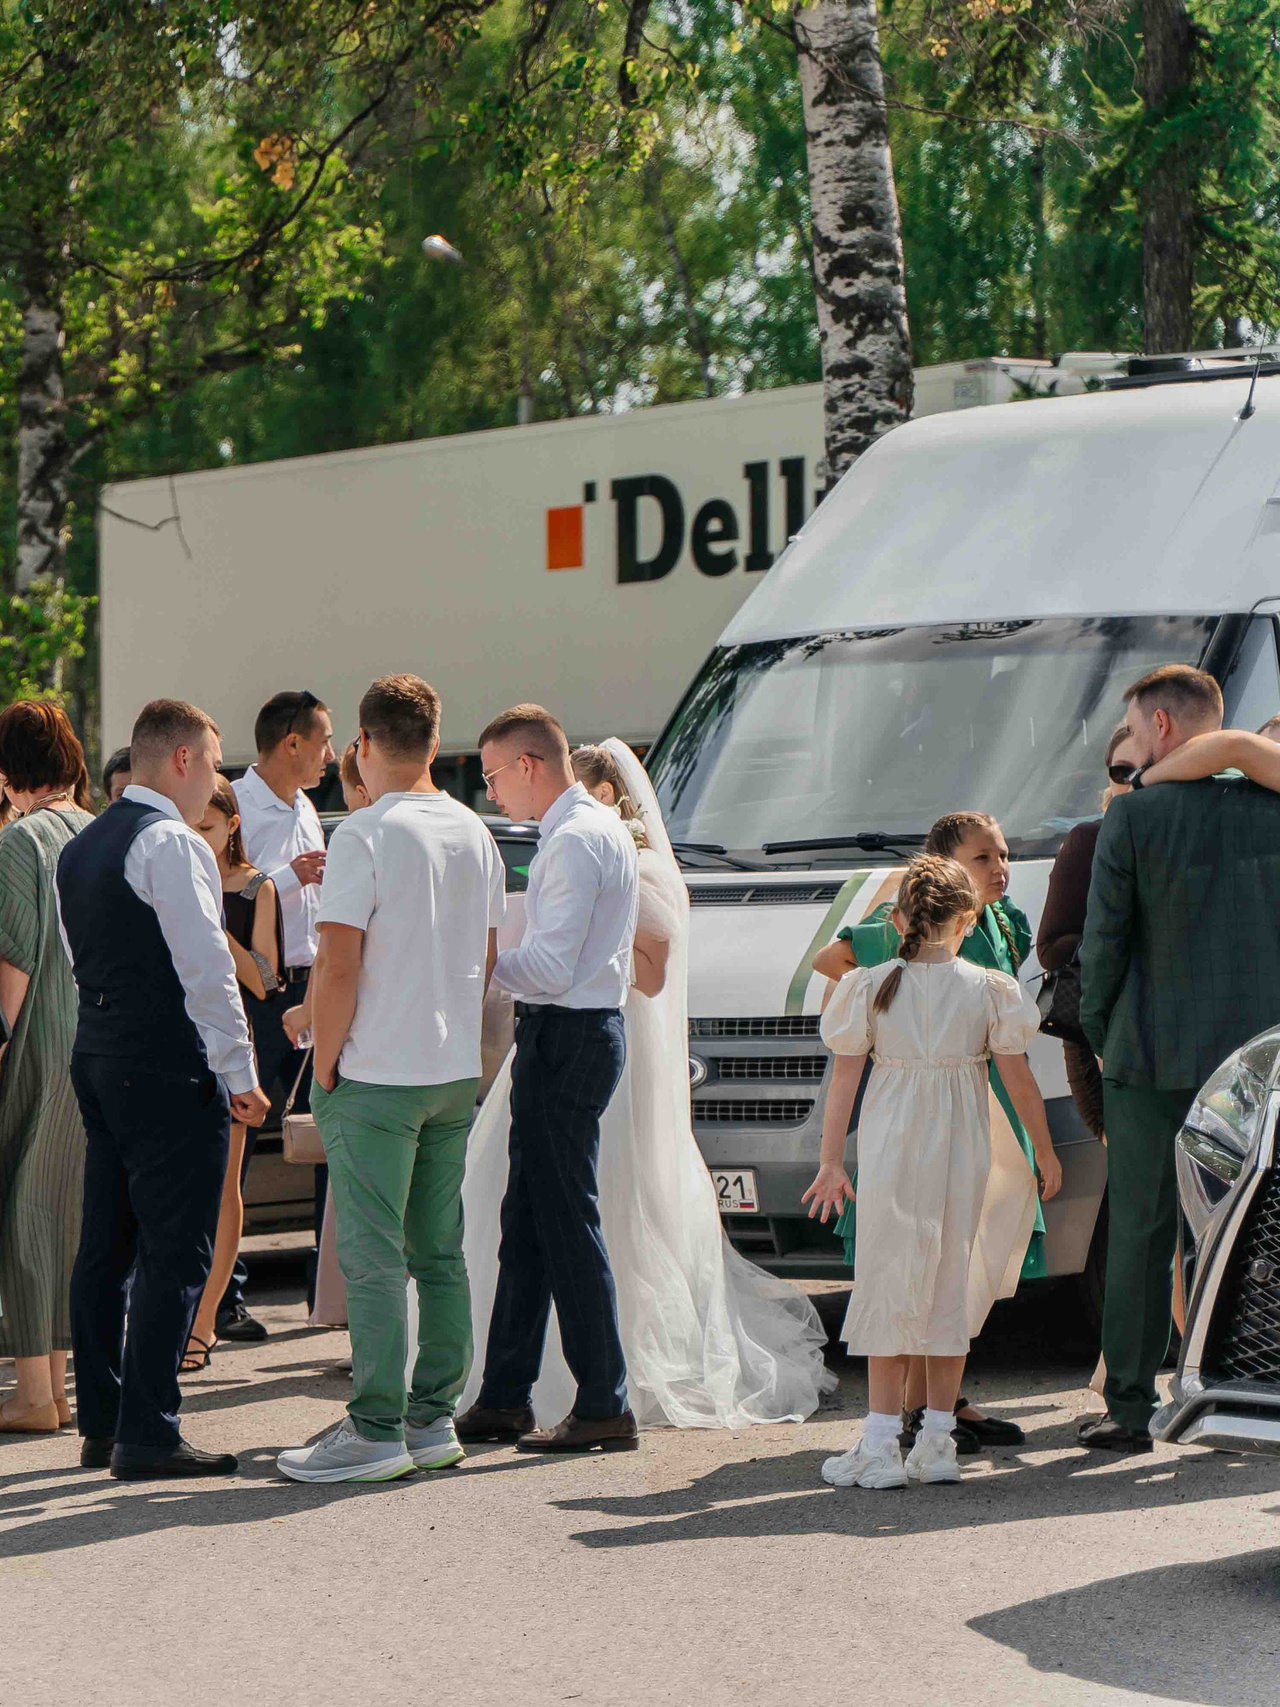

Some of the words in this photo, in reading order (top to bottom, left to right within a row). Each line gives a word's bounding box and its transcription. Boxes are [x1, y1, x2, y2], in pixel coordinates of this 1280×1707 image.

[611, 456, 825, 585] Dell
[717, 1175, 745, 1200] 21
[718, 1199, 739, 1209] RUS
